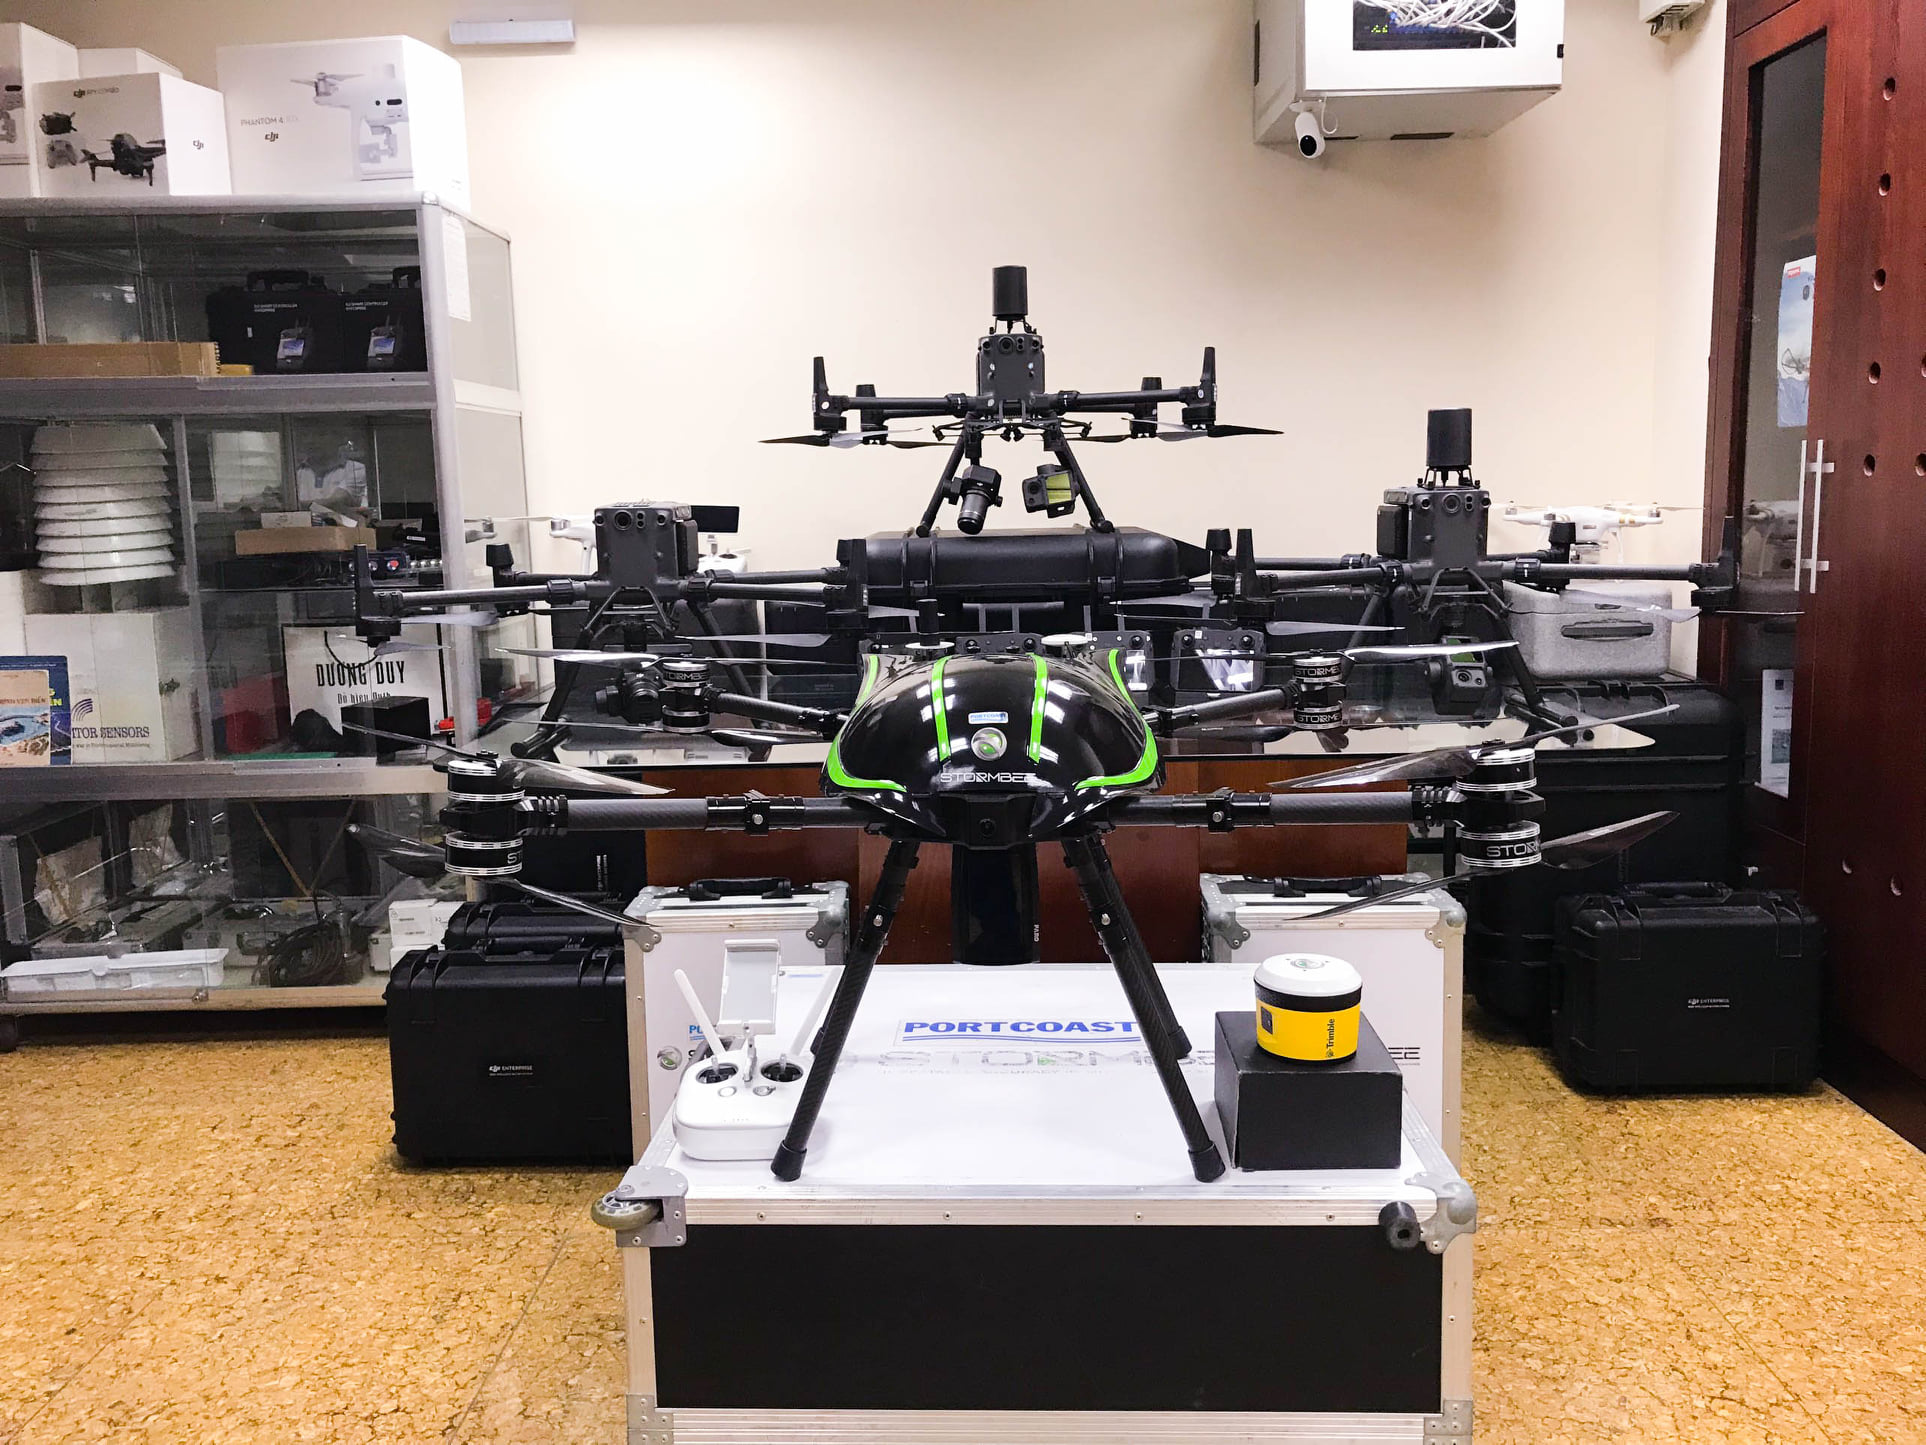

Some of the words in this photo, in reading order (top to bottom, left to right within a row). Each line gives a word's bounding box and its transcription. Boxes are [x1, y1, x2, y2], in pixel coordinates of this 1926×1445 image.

[240, 117, 277, 127] PHANTOM
[376, 661, 405, 684] DUY
[100, 726, 150, 739] SENSORS
[904, 1021, 1139, 1034] PORTCOAST
[1326, 1018, 1336, 1049] Trimble
